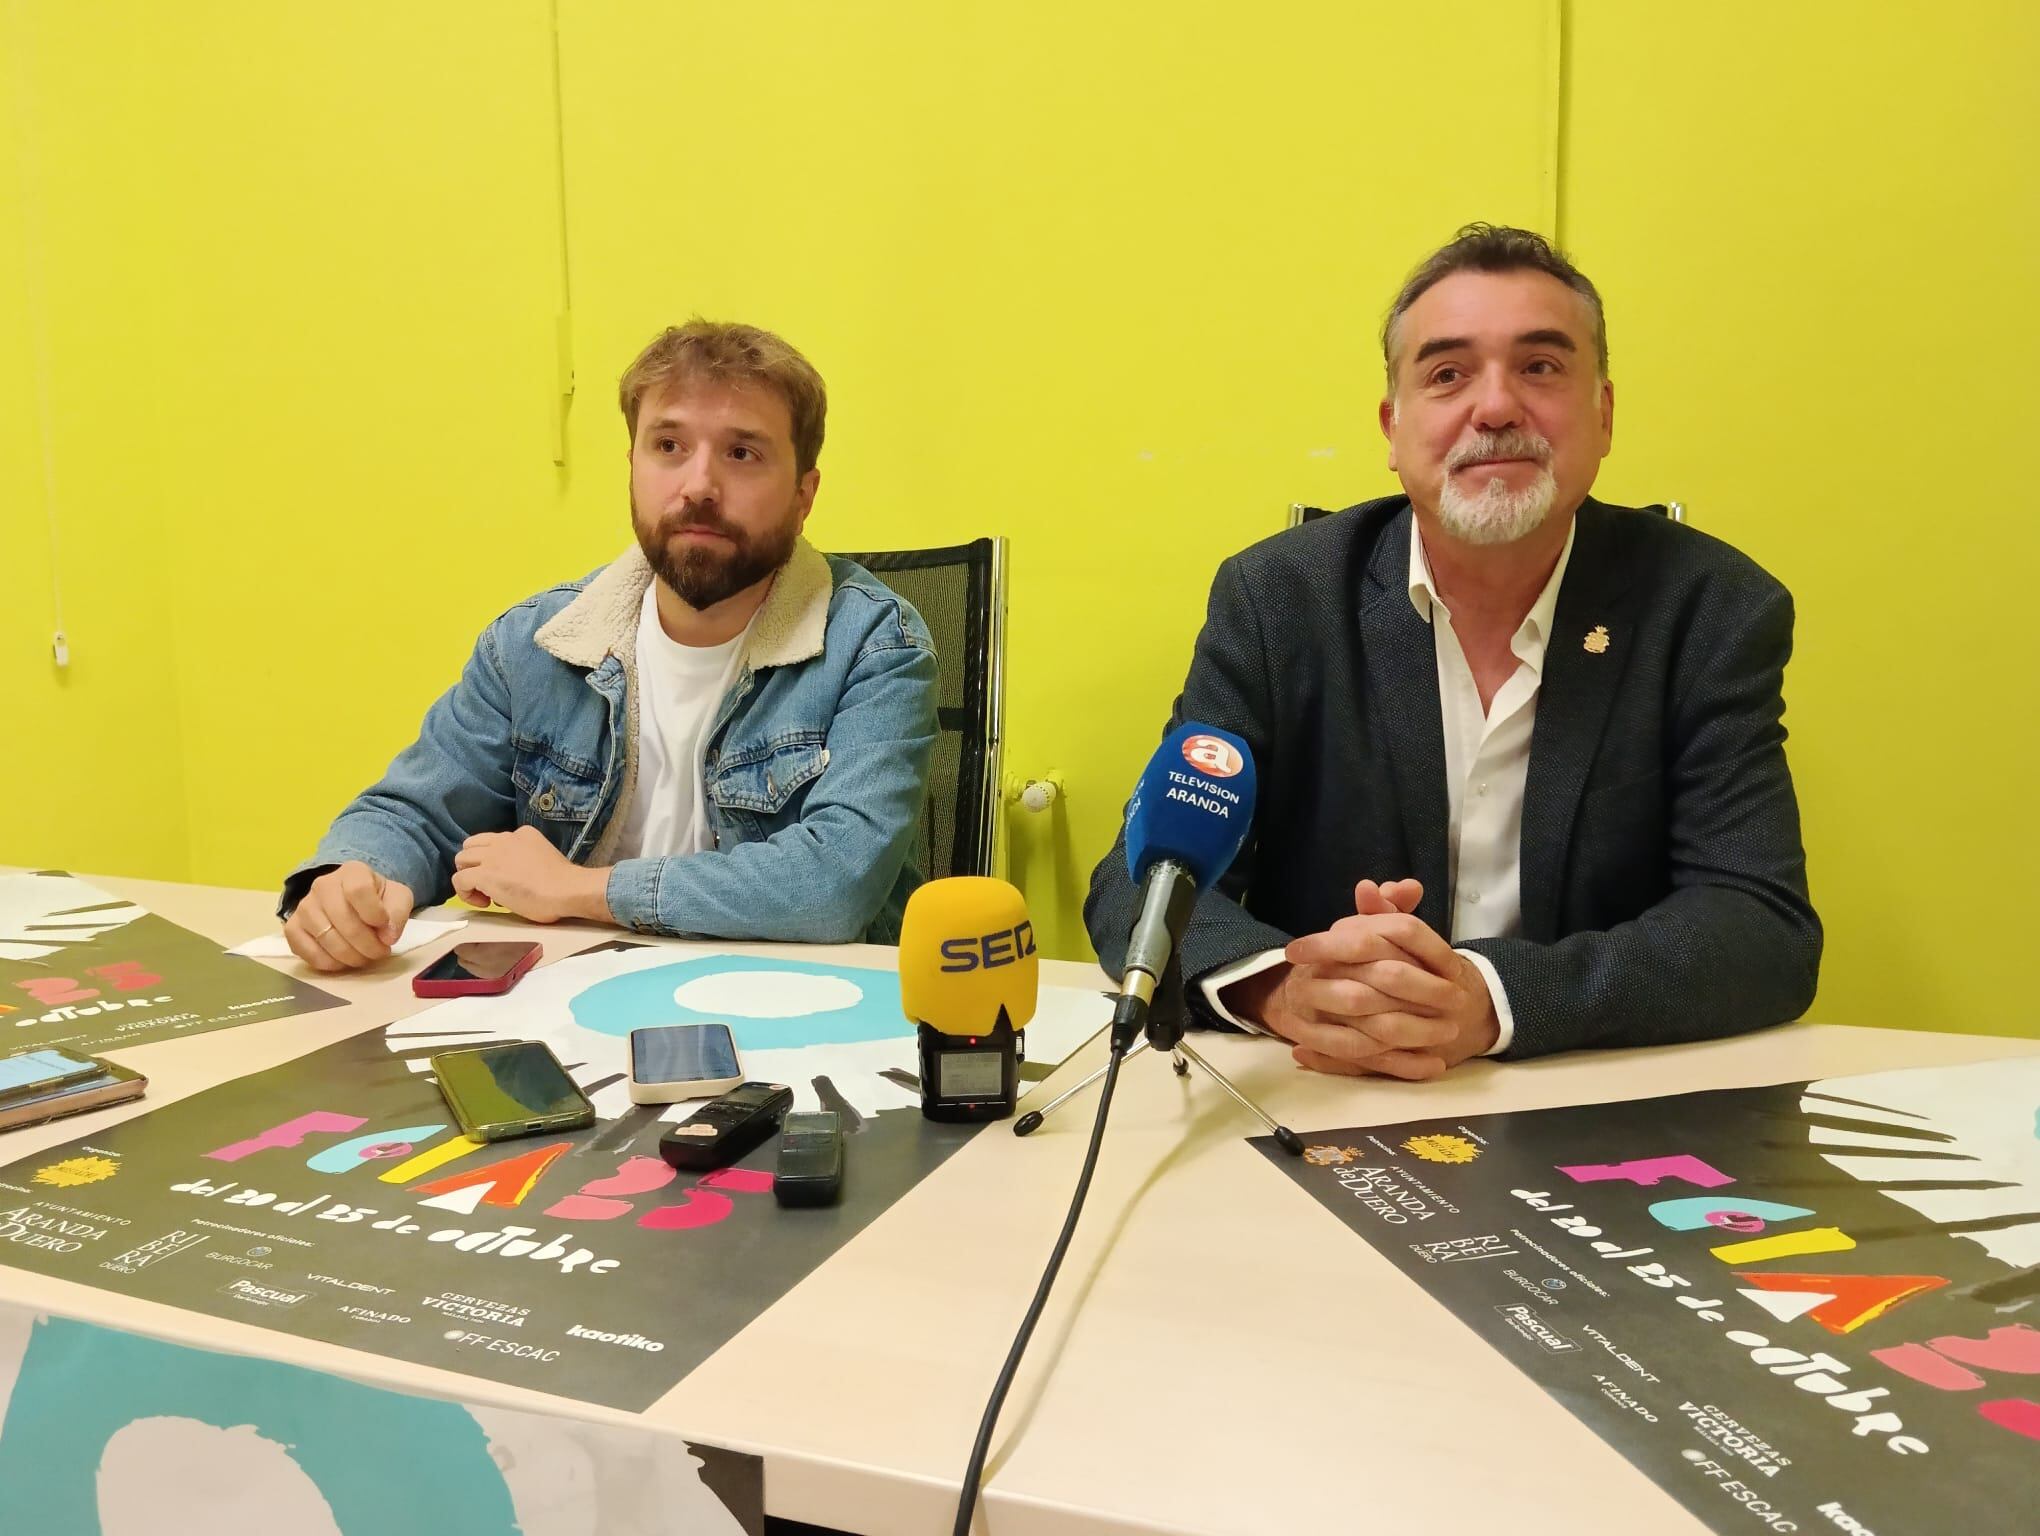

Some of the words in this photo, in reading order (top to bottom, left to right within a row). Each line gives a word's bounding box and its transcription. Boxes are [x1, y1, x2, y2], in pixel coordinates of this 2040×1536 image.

[1166, 787, 1229, 818] ARANDA
[1168, 770, 1240, 804] TELEVISION
[1333, 1166, 1357, 1181] de
[1389, 1165, 1461, 1215] AYUNTAMIENTO
[170, 1178, 239, 1197] del
[223, 1189, 278, 1206] 20
[272, 1194, 333, 1216] al
[315, 1204, 379, 1223] 25
[371, 1215, 421, 1234] de
[1338, 1177, 1409, 1226] DUERO
[1352, 1165, 1437, 1221] ARANDA
[32, 1201, 132, 1226] AYUNTAMIENTO
[205, 1251, 274, 1270] BURGOCAR
[1510, 1188, 1574, 1212] del
[1550, 1215, 1603, 1238] 20
[1590, 1241, 1655, 1259] al
[1626, 1262, 1693, 1288] 25
[1675, 1295, 1725, 1323] de
[229, 1279, 306, 1304] Pascual
[307, 1273, 397, 1295] VITALDENT
[1502, 1268, 1559, 1305] BURGOCAR
[337, 1305, 412, 1324] AFINADO
[420, 1296, 527, 1327] VICTORIA
[440, 1291, 531, 1316] CERVEZAS
[565, 1324, 665, 1352] kaotiko
[1506, 1305, 1575, 1350] Pascual
[486, 1339, 561, 1363] ESCAC
[1582, 1324, 1661, 1384] VITALDENT
[1592, 1374, 1659, 1423] AFINADO
[1677, 1401, 1782, 1479] VICTORIA
[1702, 1404, 1793, 1467] CERVEZAS
[1719, 1479, 1799, 1534] ESCAC
